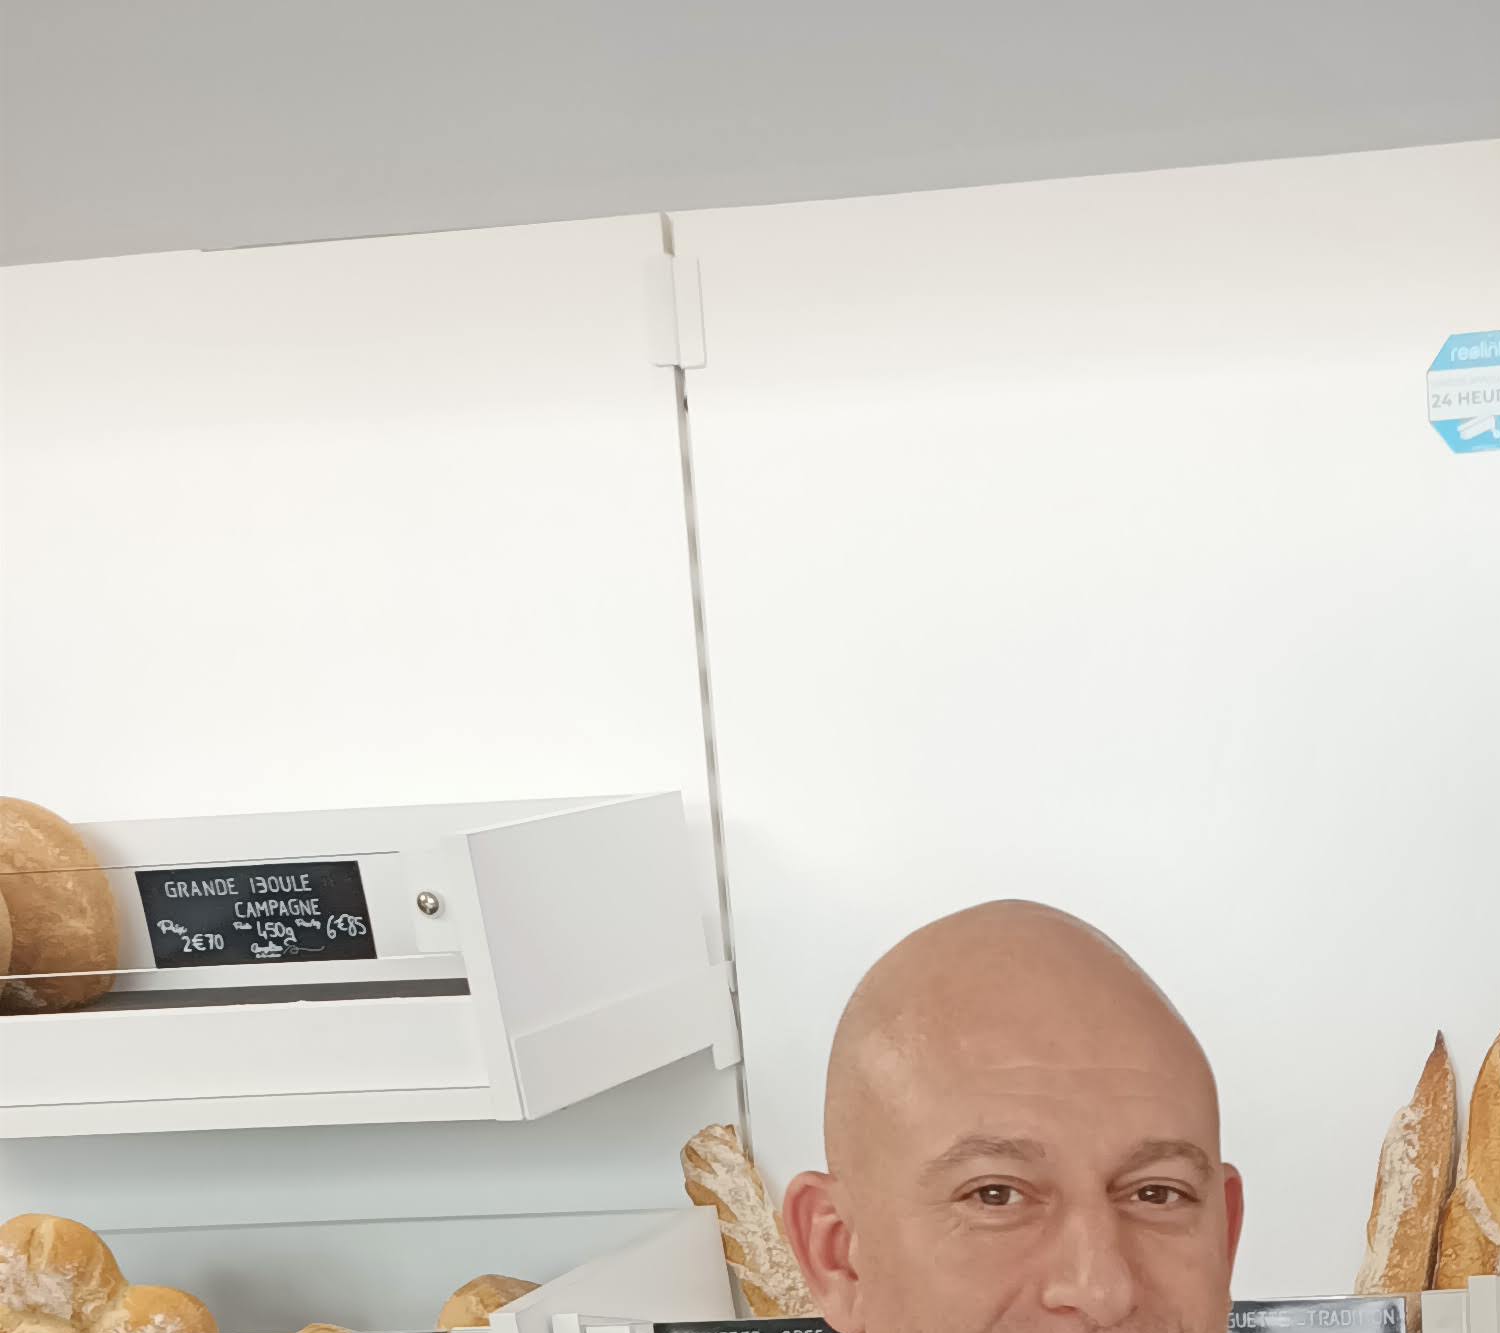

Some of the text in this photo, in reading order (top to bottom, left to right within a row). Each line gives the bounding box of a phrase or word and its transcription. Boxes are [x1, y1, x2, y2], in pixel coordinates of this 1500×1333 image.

[1431, 393, 1452, 409] 24
[164, 873, 313, 898] GRANDE BOULE
[234, 898, 322, 919] CAMPAGNE
[256, 921, 298, 947] 450g
[326, 914, 367, 939] 6€85
[181, 933, 225, 953] 2€70
